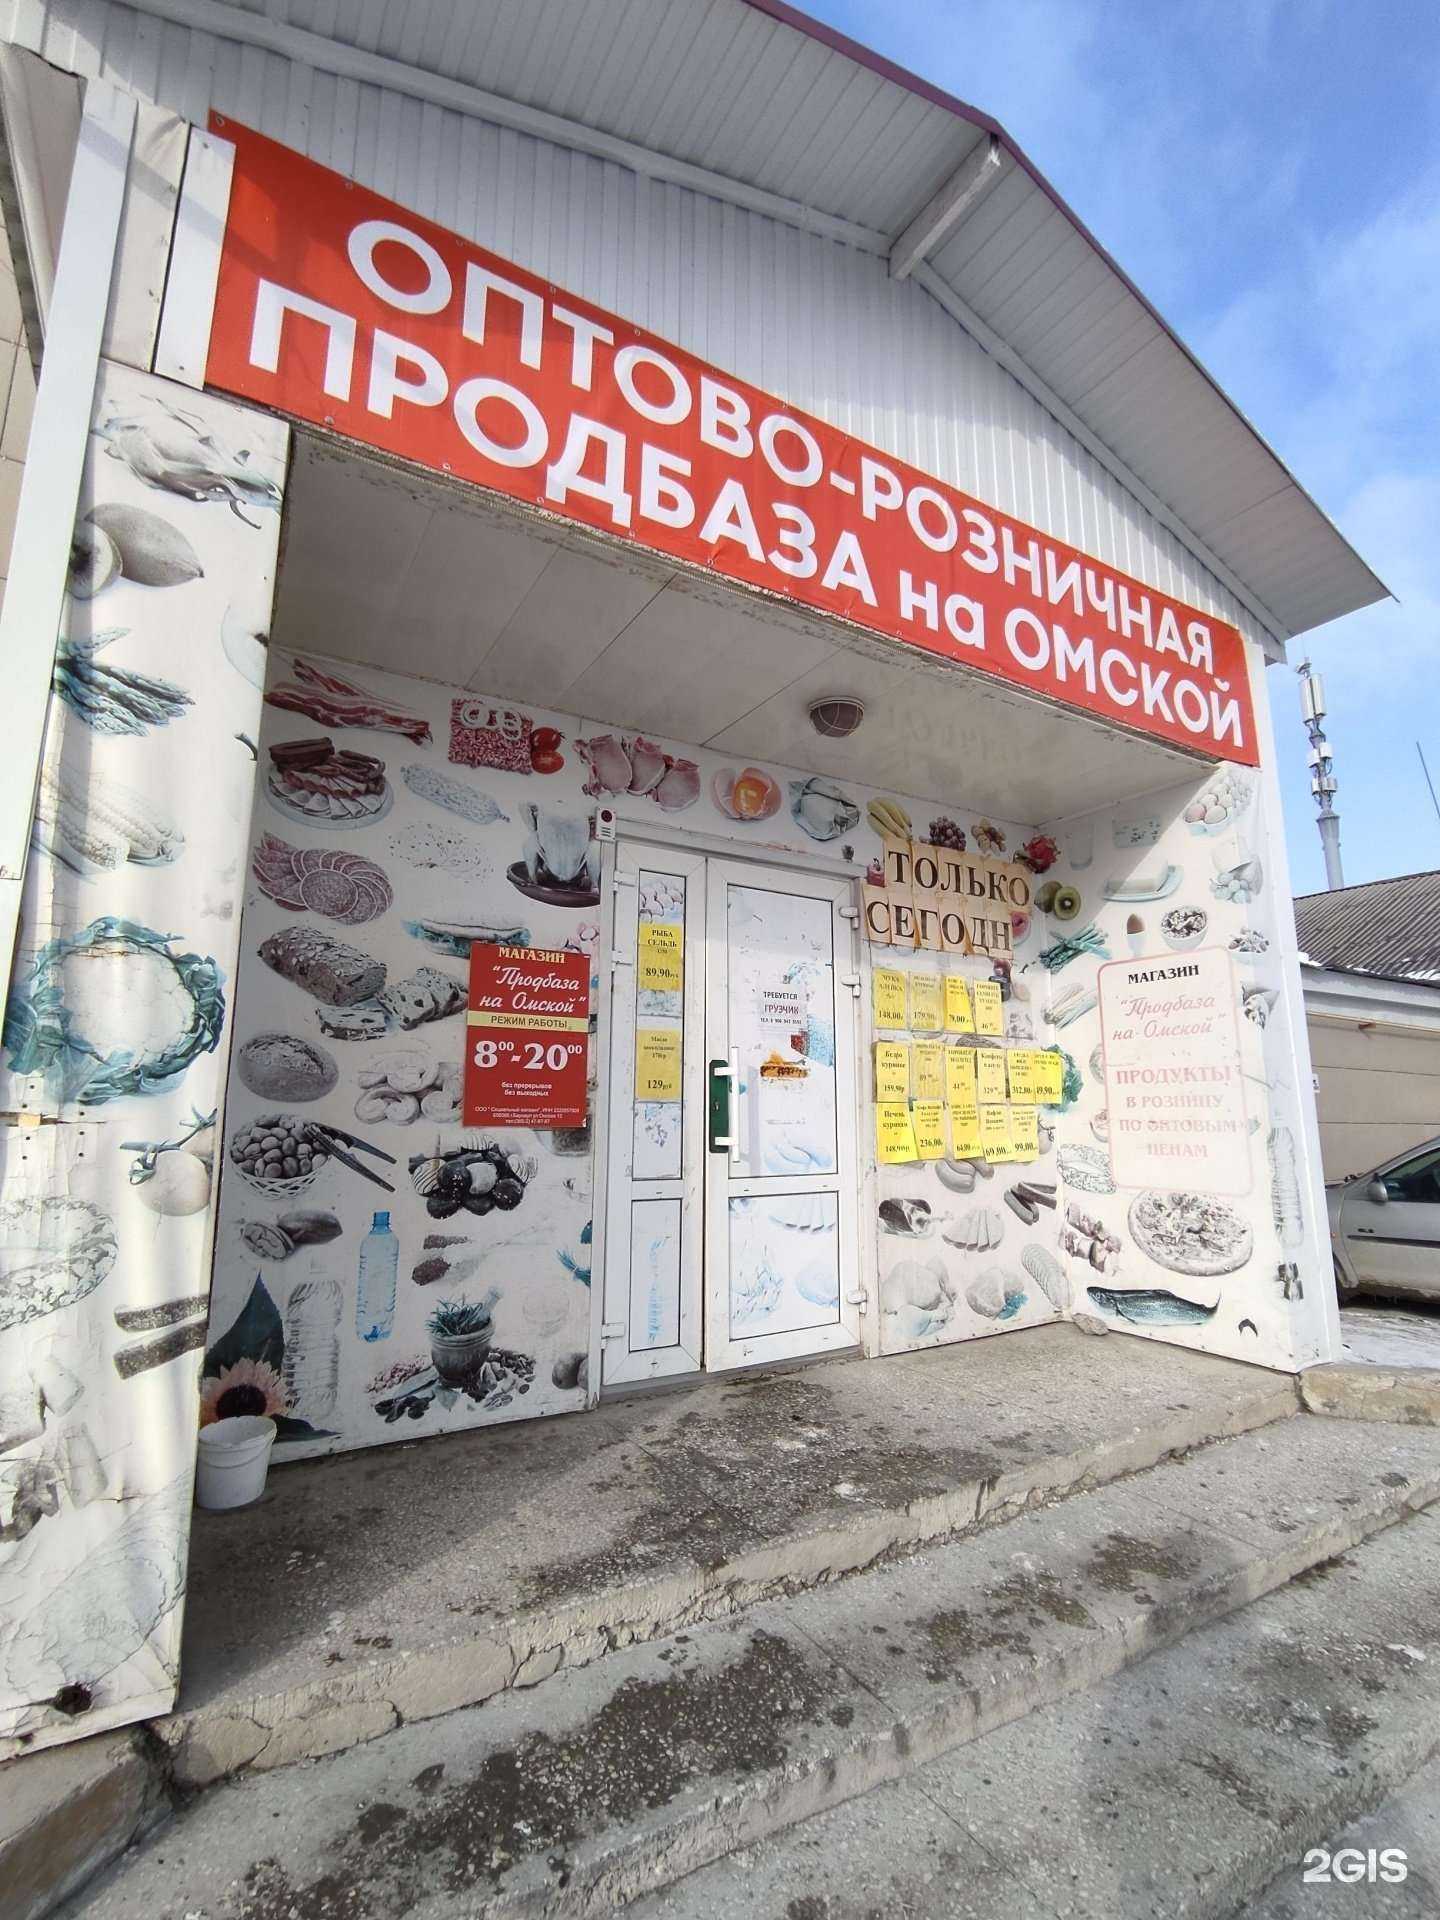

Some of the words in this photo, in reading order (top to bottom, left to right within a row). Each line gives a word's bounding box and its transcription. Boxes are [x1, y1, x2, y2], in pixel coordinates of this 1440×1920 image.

[347, 219, 1213, 674] ОПТОВО-РОЗНИЧНАЯ
[249, 278, 879, 607] ПРОДБАЗА
[900, 569, 985, 649] на
[1004, 608, 1244, 748] ОМСКОЙ
[888, 851, 1030, 906] ТОЛЬКО
[652, 929, 674, 938] РЫБА
[866, 901, 1011, 957] СЕГОДН
[647, 939, 678, 948] СЕЛЬДЬ
[499, 946, 566, 964] МАГАЗИН
[1128, 964, 1200, 985] МАГАЗИН
[480, 996, 503, 1008] на
[763, 991, 798, 1000] ТРЕБУЕТСЯ
[764, 1004, 799, 1015] ГРУЗЧИК
[490, 1015, 527, 1026] РЕЖИМ
[528, 1018, 568, 1028] РАБОТЫ
[1112, 1028, 1135, 1041] на
[1117, 1065, 1232, 1085] ПРОДУКТЫ
[1126, 1096, 1136, 1108] В
[1142, 1094, 1224, 1111] РОЗНИЦУ
[1119, 1119, 1141, 1132] ПО
[1146, 1118, 1238, 1134] ОПТОВЫМ
[1147, 1143, 1209, 1158] ЦЕНАМ
